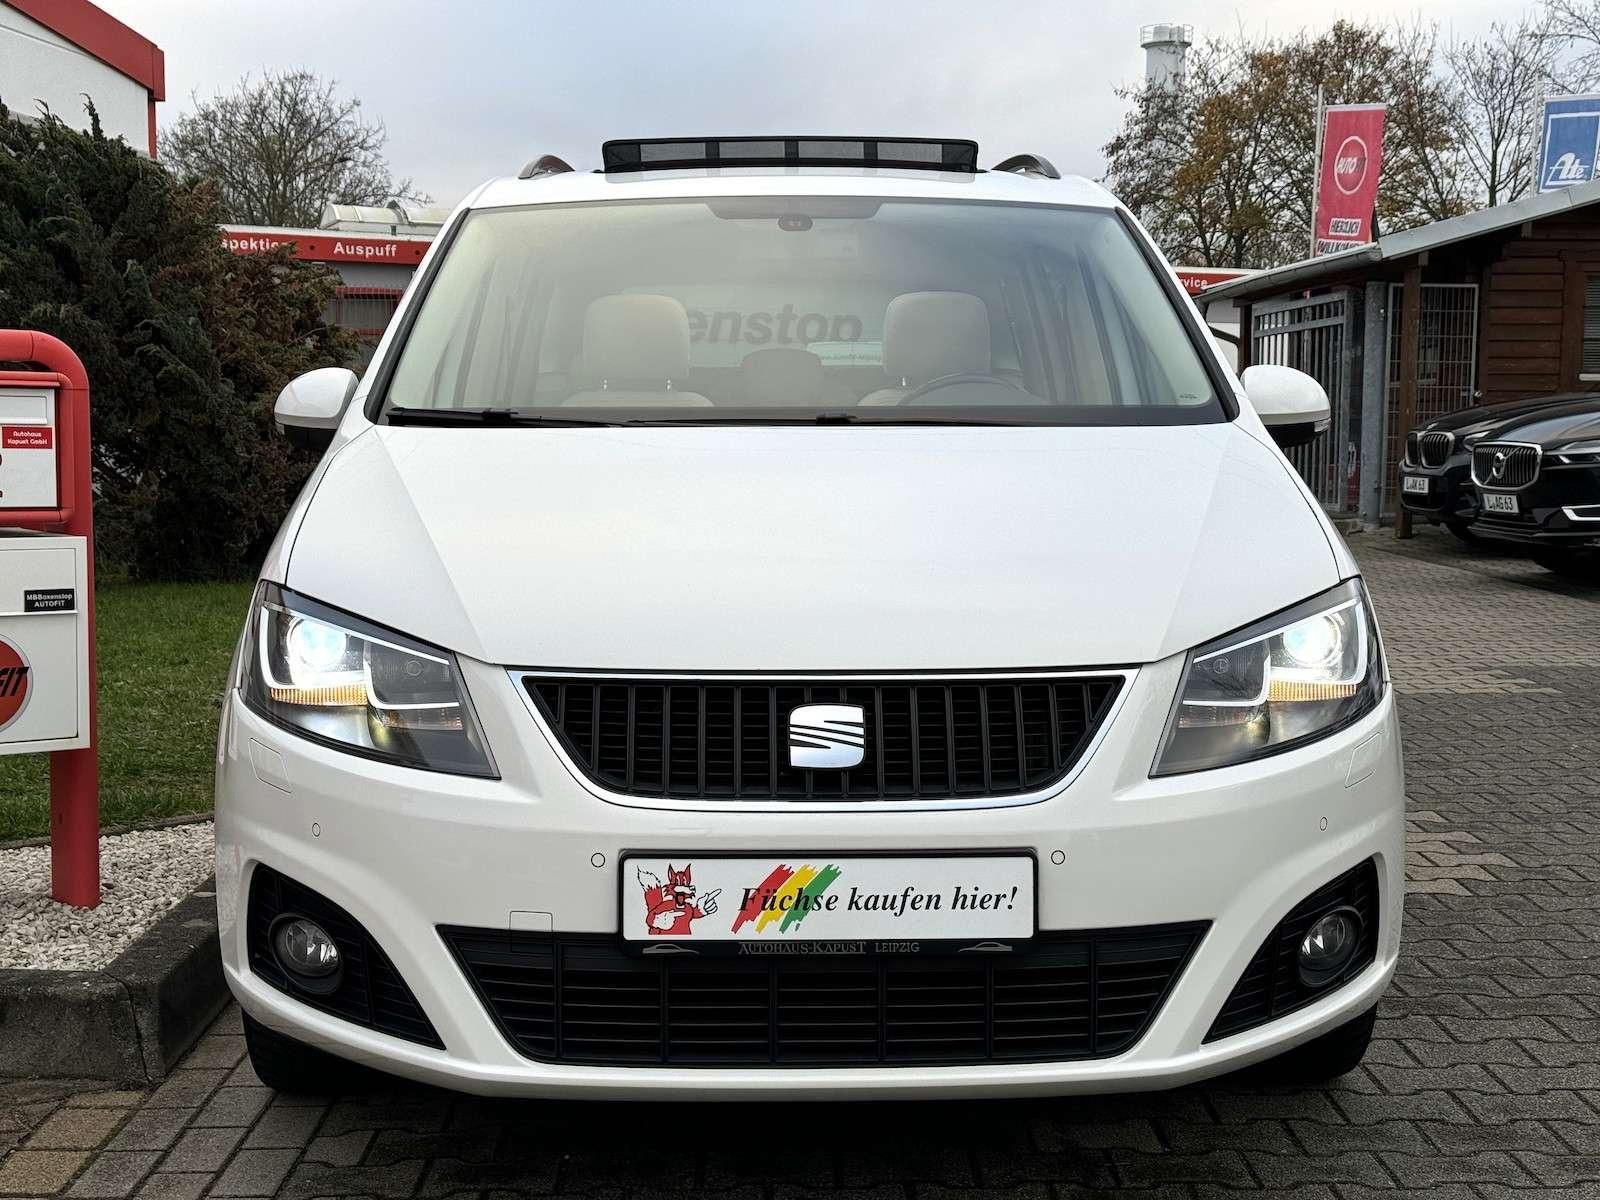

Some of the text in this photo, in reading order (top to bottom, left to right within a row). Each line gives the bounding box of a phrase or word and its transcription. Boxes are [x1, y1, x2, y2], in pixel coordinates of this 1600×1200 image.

[333, 241, 398, 259] Auspuff
[13, 430, 42, 438] Autohaus
[7, 438, 29, 446] Kapust
[26, 593, 73, 601] MBBoxenstop
[34, 600, 66, 608] AUTOFIT
[738, 886, 1019, 918] Füchse kaufen hier!
[875, 942, 921, 953] LEIPZIG
